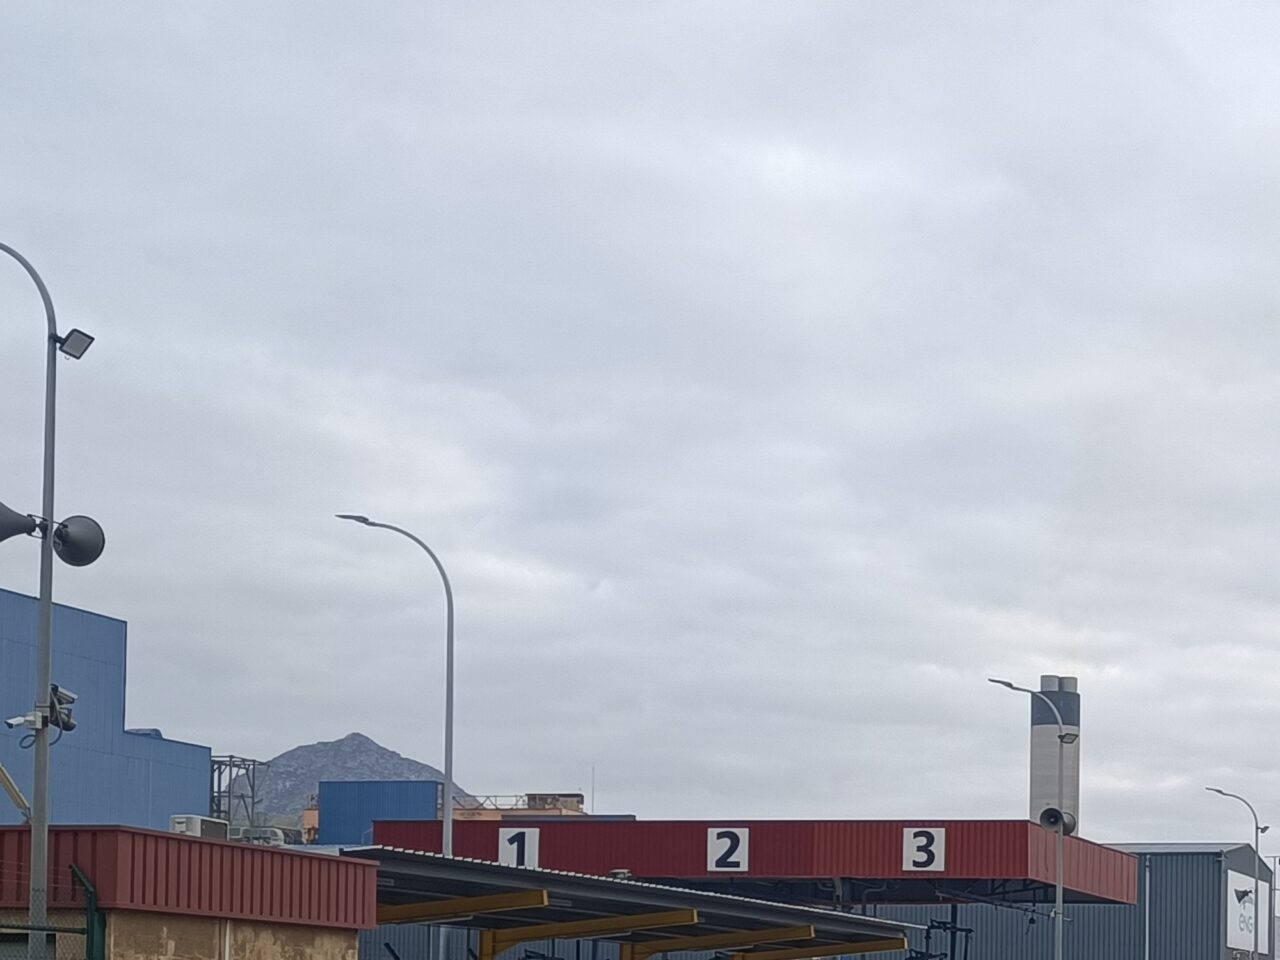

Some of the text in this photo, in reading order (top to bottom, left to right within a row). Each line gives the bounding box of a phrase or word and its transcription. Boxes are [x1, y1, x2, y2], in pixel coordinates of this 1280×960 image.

[507, 831, 528, 868] 1
[714, 830, 741, 868] 2
[911, 830, 936, 868] 3
